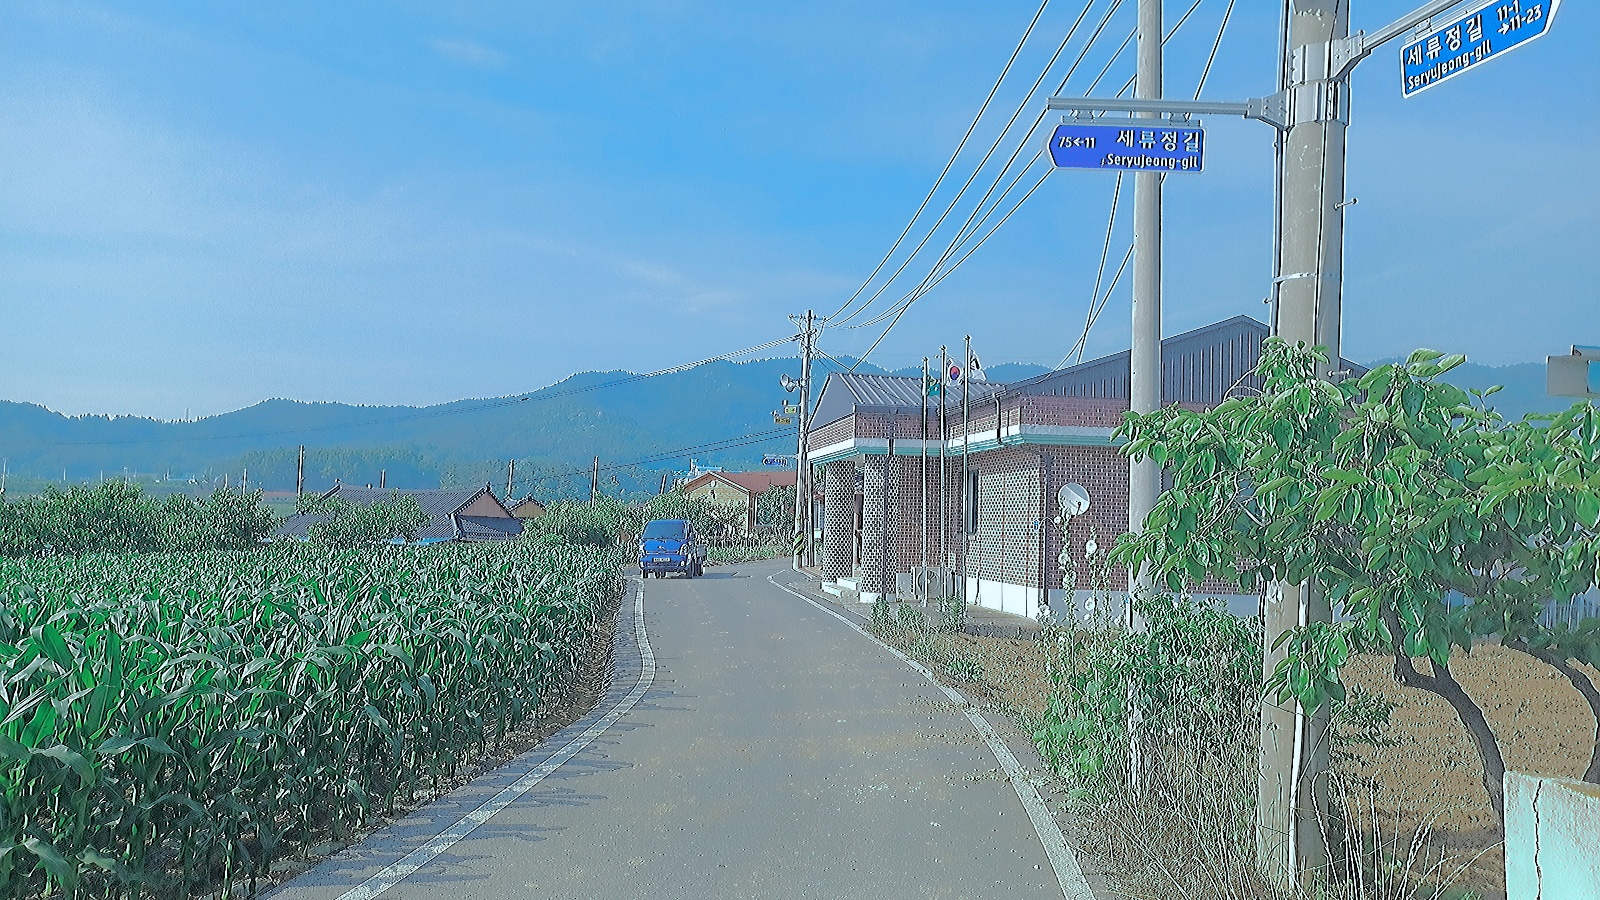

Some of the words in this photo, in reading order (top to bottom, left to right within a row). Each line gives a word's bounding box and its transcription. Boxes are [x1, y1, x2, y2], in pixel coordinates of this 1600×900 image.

[1497, 0, 1520, 22] 11-1
[1510, 4, 1543, 31] 11-23
[1406, 13, 1483, 66] 세류정길
[1407, 39, 1492, 90] Seryujeong-gil
[1116, 129, 1200, 153] 세류정길
[1106, 153, 1199, 170] Seryujeong-gil
